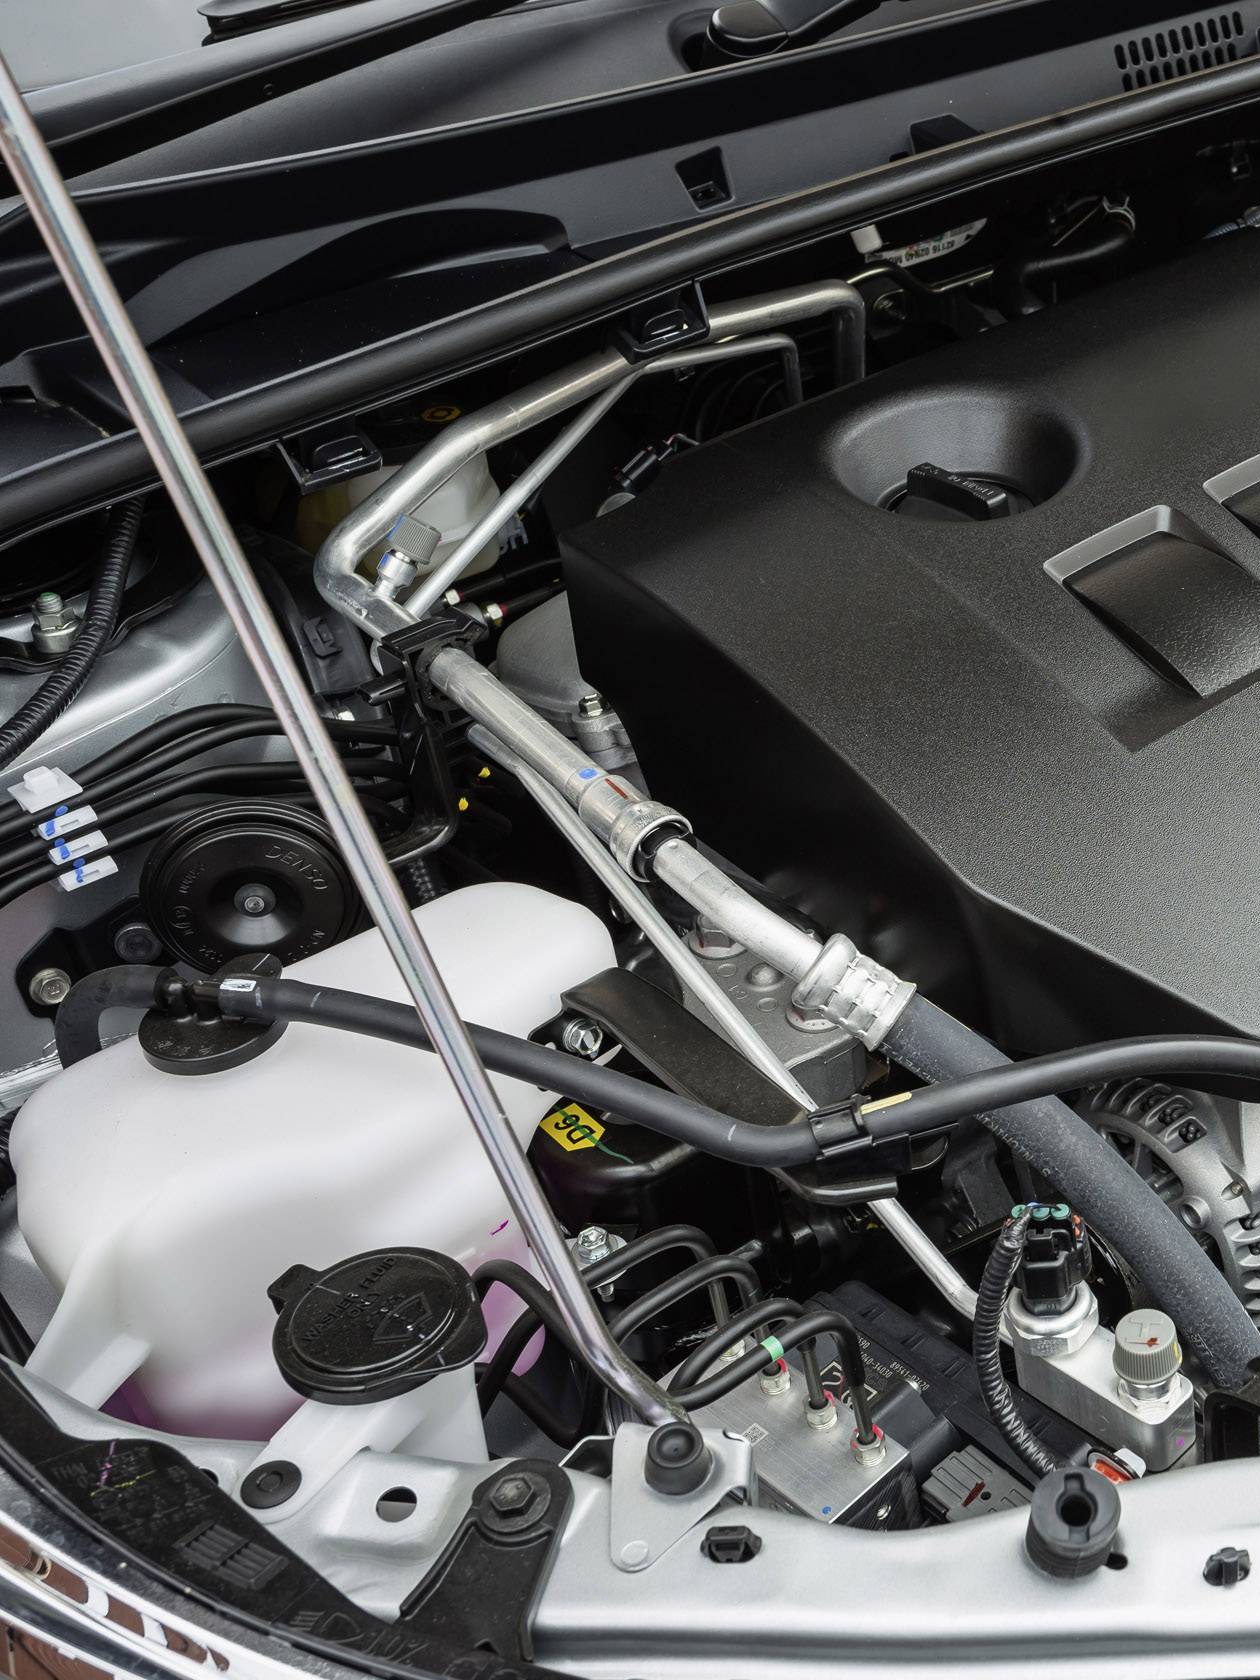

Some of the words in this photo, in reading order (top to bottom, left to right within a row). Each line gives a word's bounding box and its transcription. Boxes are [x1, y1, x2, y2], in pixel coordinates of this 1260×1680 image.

[264, 844, 329, 891] DENSO
[302, 1291, 360, 1343] WASHER
[359, 1256, 397, 1289] FLUID
